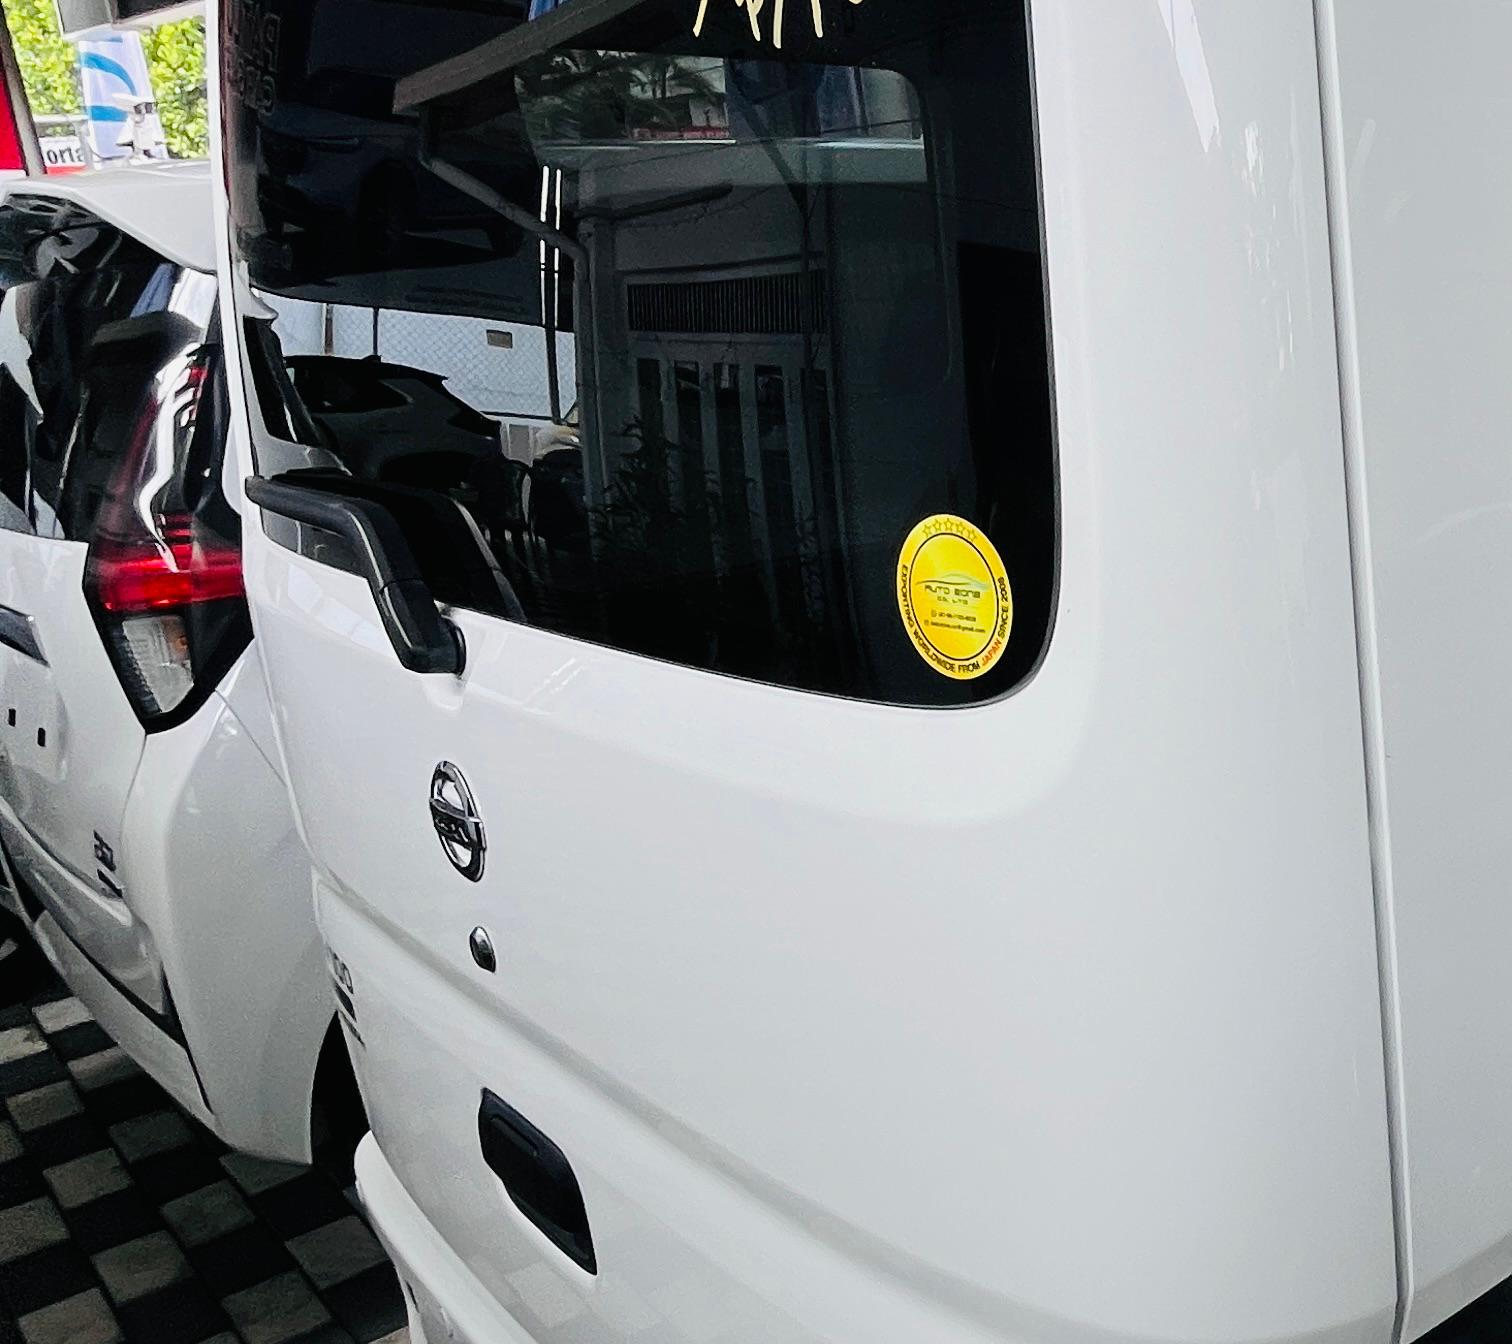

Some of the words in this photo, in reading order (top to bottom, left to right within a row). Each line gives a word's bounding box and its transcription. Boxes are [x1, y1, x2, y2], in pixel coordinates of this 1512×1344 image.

[901, 564, 915, 629] EXPORTING
[913, 629, 956, 673] WORLDWIDE
[957, 660, 980, 674] FROM
[981, 639, 1003, 667] JAPAN
[998, 605, 1009, 639] SINCE
